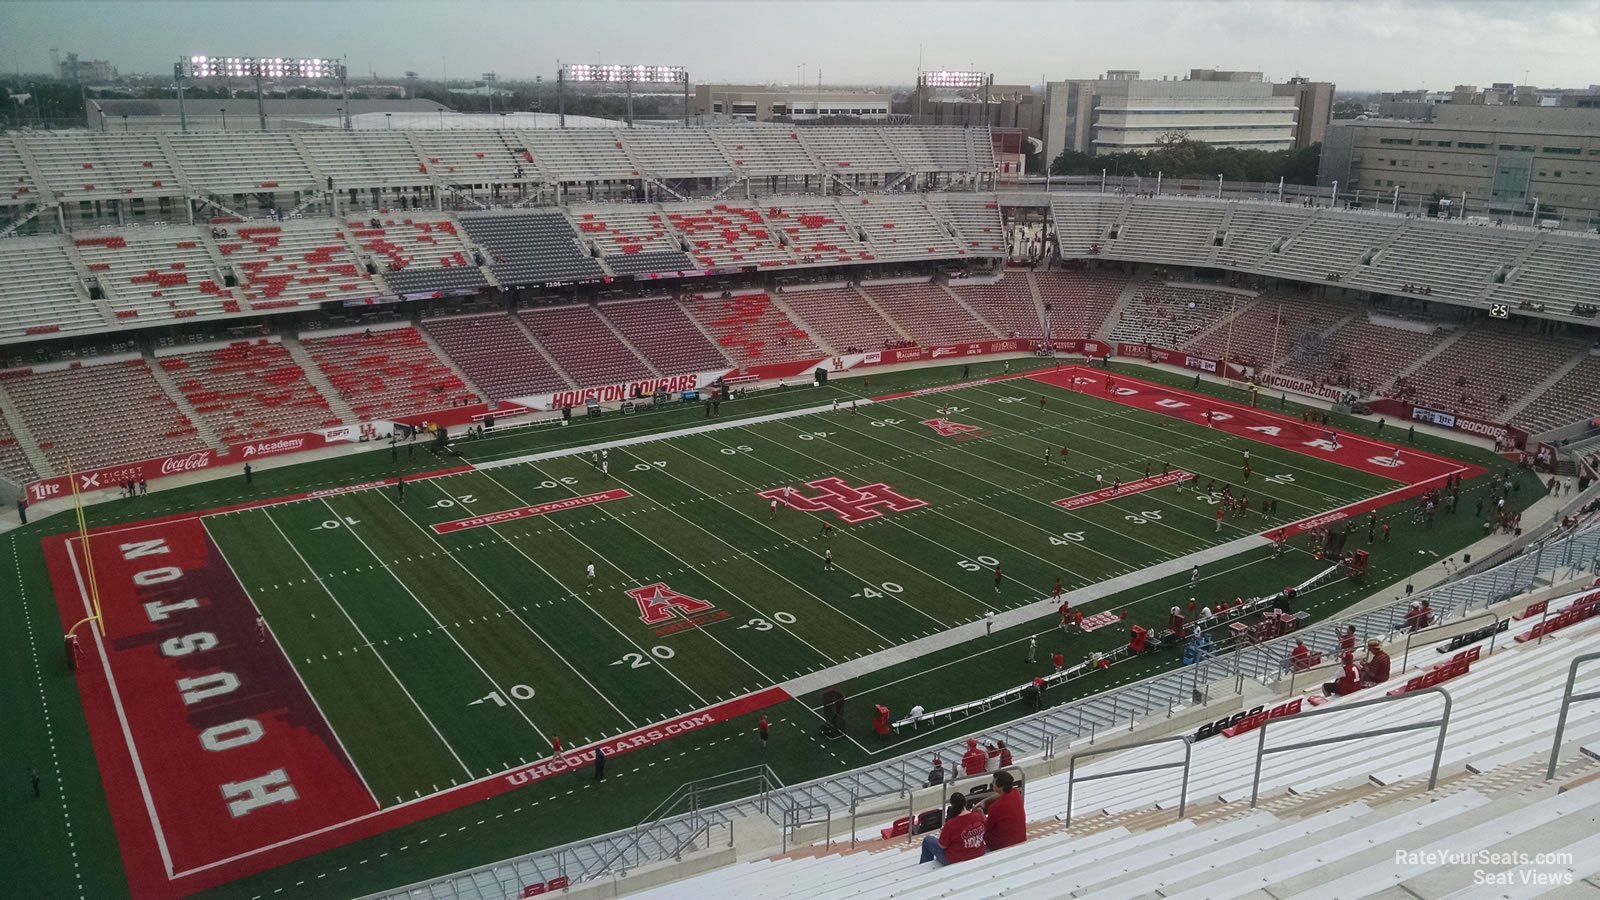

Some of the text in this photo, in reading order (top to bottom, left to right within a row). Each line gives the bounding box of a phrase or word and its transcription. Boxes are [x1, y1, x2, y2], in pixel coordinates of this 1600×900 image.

[1491, 304, 1507, 317] 25
[552, 374, 697, 409] HOUSTON COUGARS
[327, 428, 350, 438] ESPN
[257, 438, 304, 452] Academy
[162, 451, 211, 474] Coca-Cola
[103, 467, 142, 479] TICKET
[32, 483, 60, 500] Lite
[456, 494, 610, 528] TDECU STADIUM
[1049, 531, 1085, 546] 40
[957, 555, 999, 572] 50
[863, 582, 904, 599] 40
[748, 611, 797, 631] 30
[621, 645, 675, 669] 20
[119, 538, 298, 818] HOUSTON
[482, 684, 535, 708] 10
[505, 713, 715, 786] UHCOUGARS.COM
